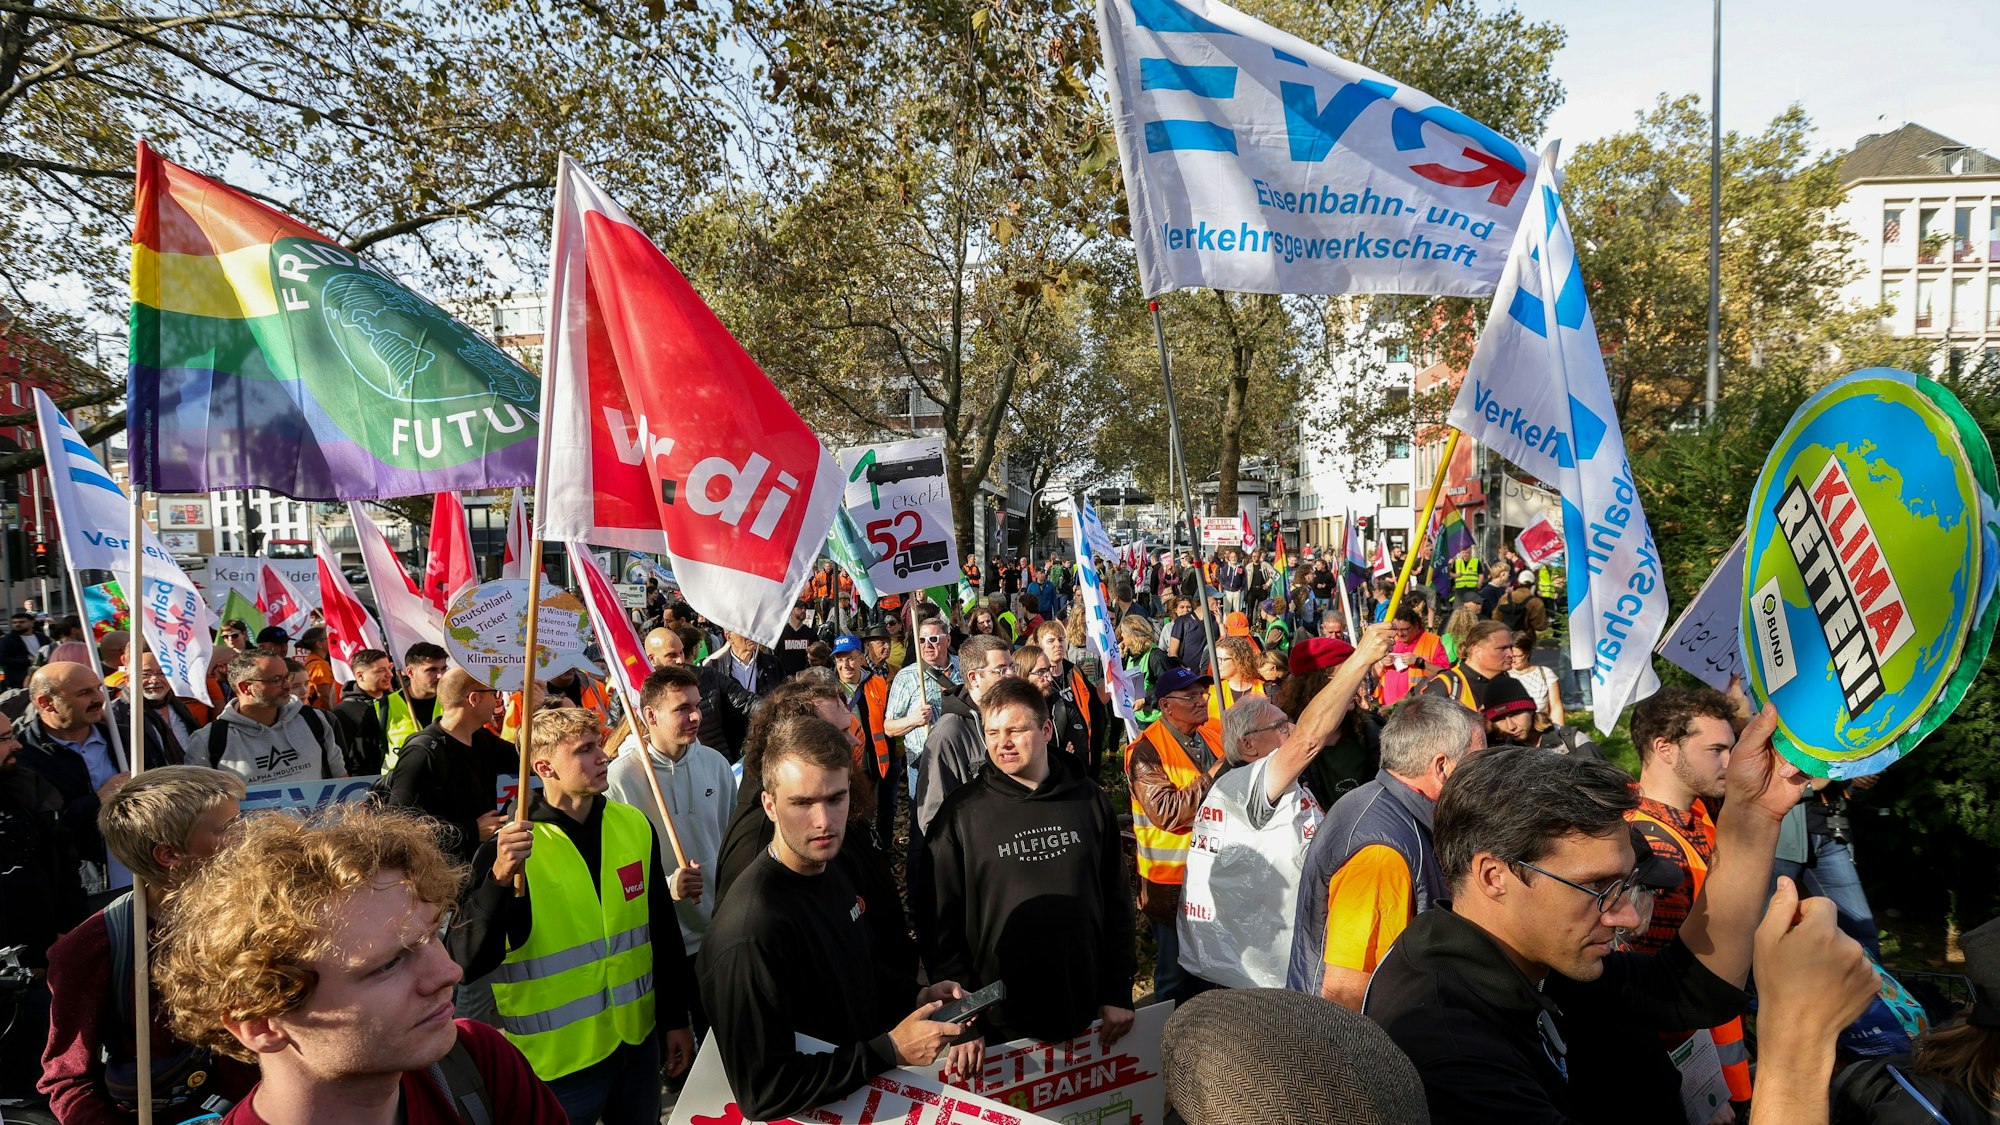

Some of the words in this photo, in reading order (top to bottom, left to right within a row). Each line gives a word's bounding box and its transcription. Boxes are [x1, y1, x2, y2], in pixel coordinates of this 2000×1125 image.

[1135, 0, 1527, 207] EVG
[1252, 178, 1416, 217] Eisenbahn-
[1426, 205, 1495, 241] und
[1161, 221, 1478, 267] Verkehrsgewerkschaft
[892, 481, 946, 510] ersetzt
[866, 510, 928, 562] 52
[1812, 463, 1904, 657] KLIMA
[215, 567, 255, 583] Kein
[450, 589, 513, 628] Deutschland
[547, 607, 573, 618] Wissing
[1777, 484, 1881, 712] RETTEN!
[555, 629, 568, 637] den
[784, 639, 808, 651] MARVEL
[1766, 616, 1784, 668] BUND
[467, 653, 526, 664] Klimaschut
[248, 771, 275, 784] ALPHA
[272, 761, 312, 779] INDUSTRIES
[997, 830, 1081, 858] HILFIGER
[1014, 825, 1062, 839] ESTABLISHED
[1019, 847, 1067, 861] MCMLXXXV
[1032, 1061, 1117, 1108] BAHN
